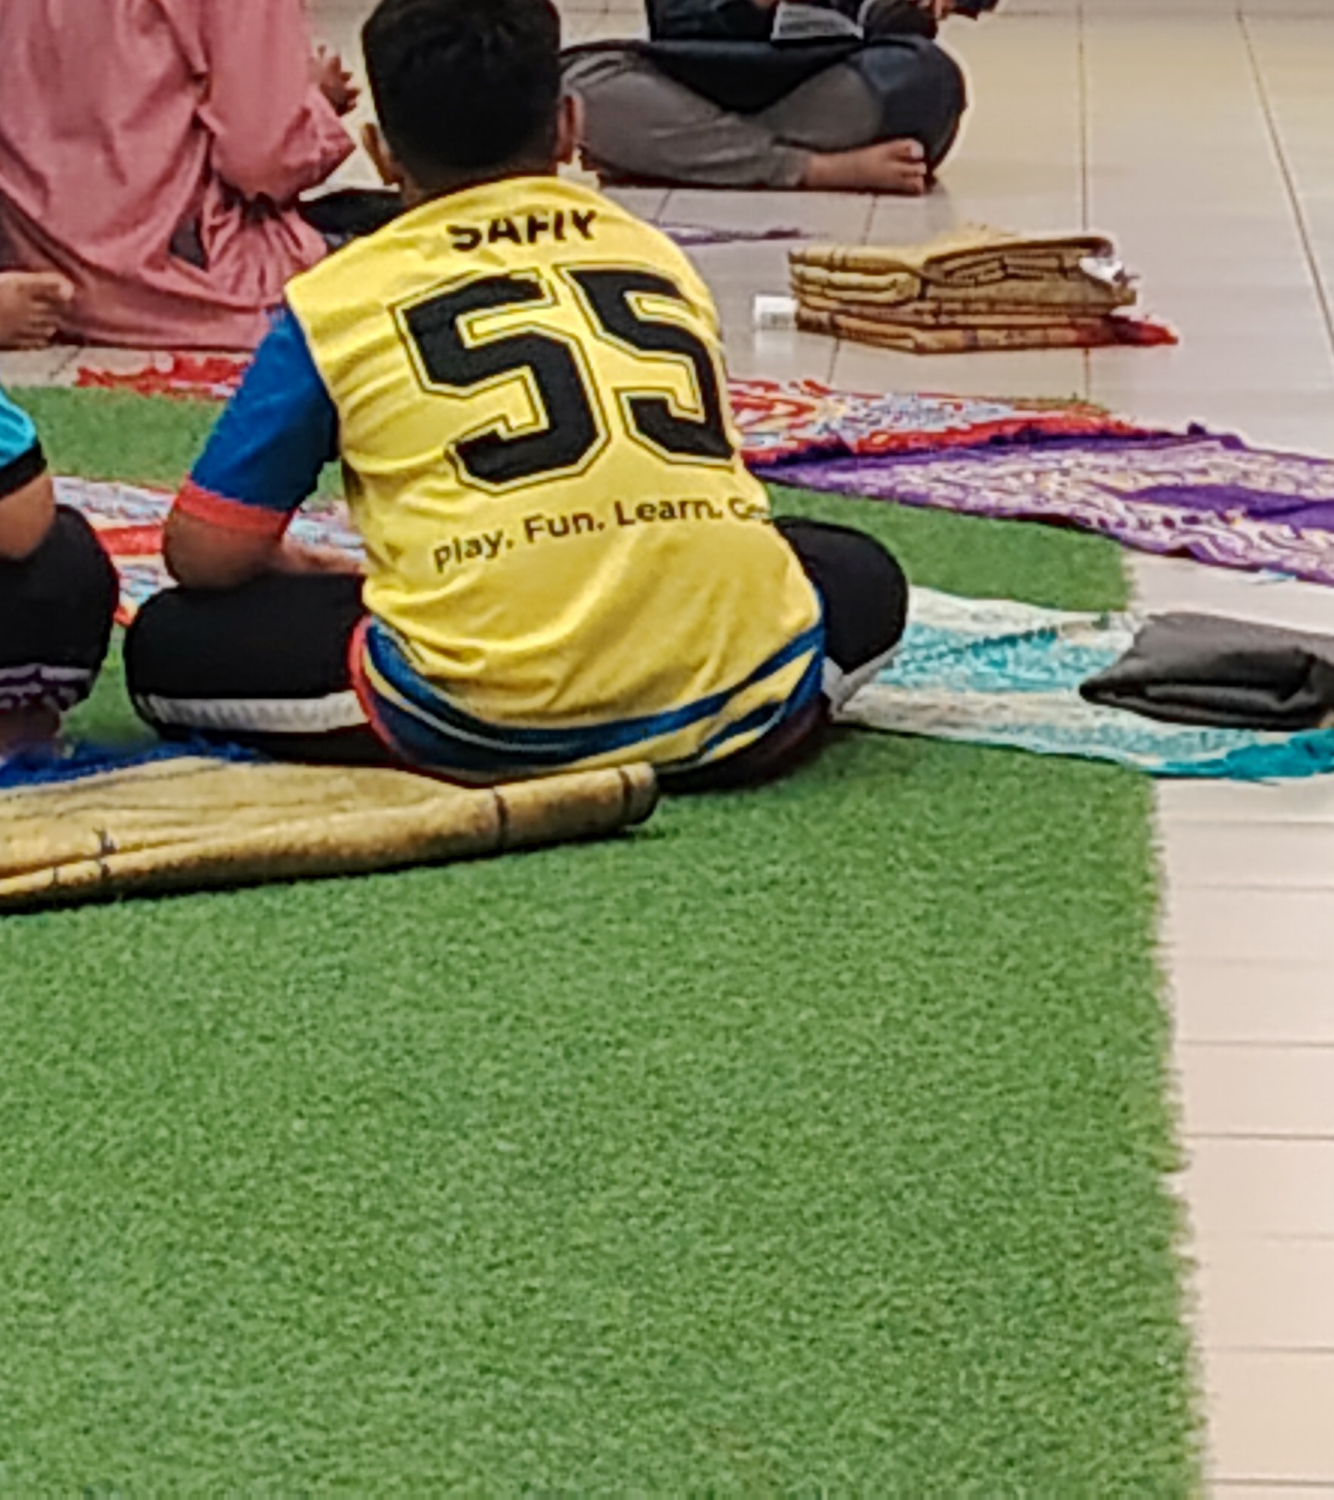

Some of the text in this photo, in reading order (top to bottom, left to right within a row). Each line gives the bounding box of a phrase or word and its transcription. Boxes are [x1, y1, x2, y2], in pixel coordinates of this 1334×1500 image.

[393, 264, 735, 492] 55
[523, 509, 606, 543] Fun.
[614, 498, 723, 526] Learn.
